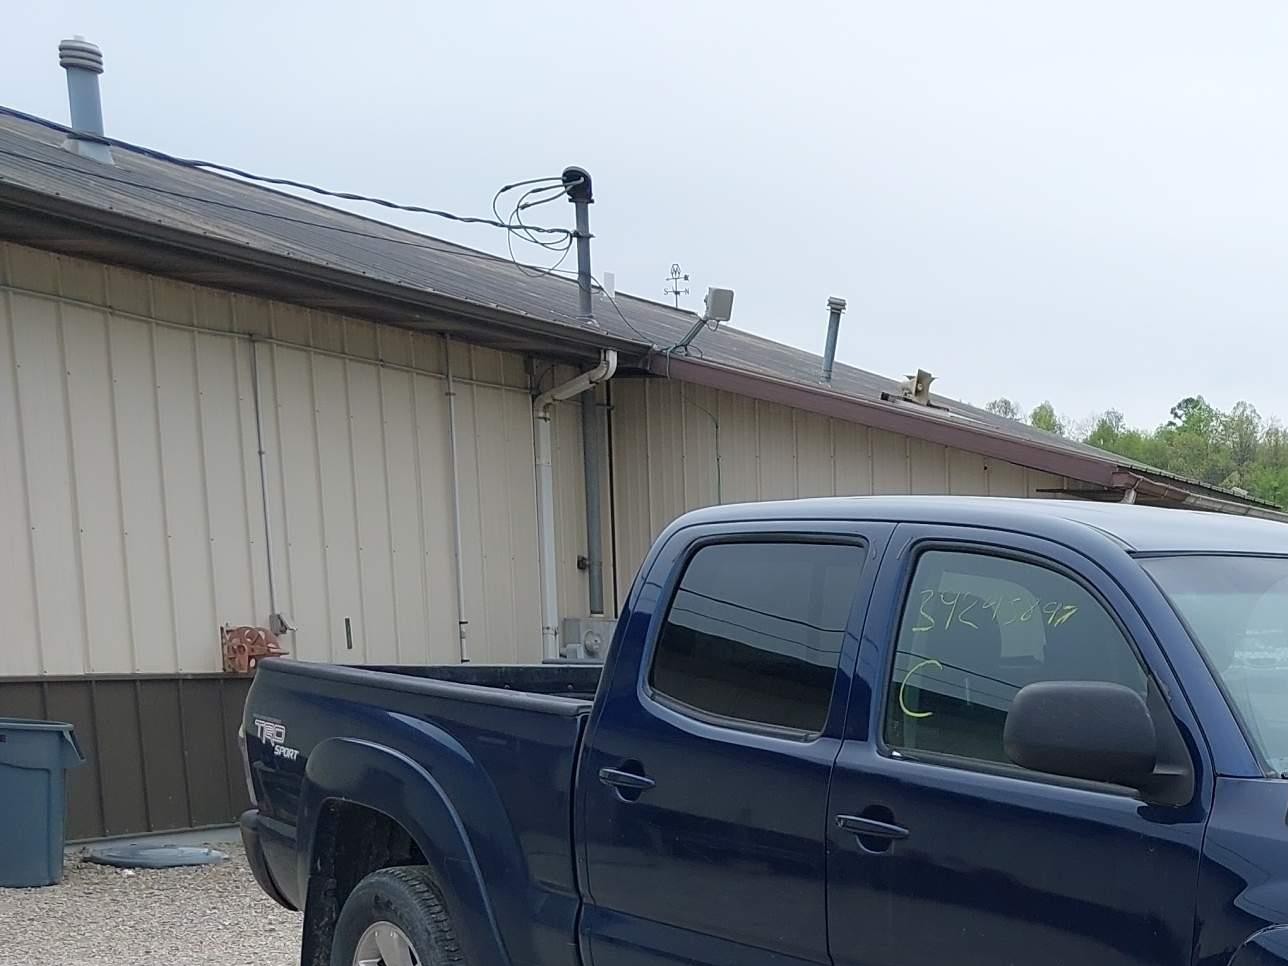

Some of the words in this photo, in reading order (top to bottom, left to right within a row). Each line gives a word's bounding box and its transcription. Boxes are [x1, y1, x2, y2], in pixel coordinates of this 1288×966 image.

[899, 659, 943, 718] C
[254, 719, 286, 747] TRD
[273, 744, 300, 761] SPORT
